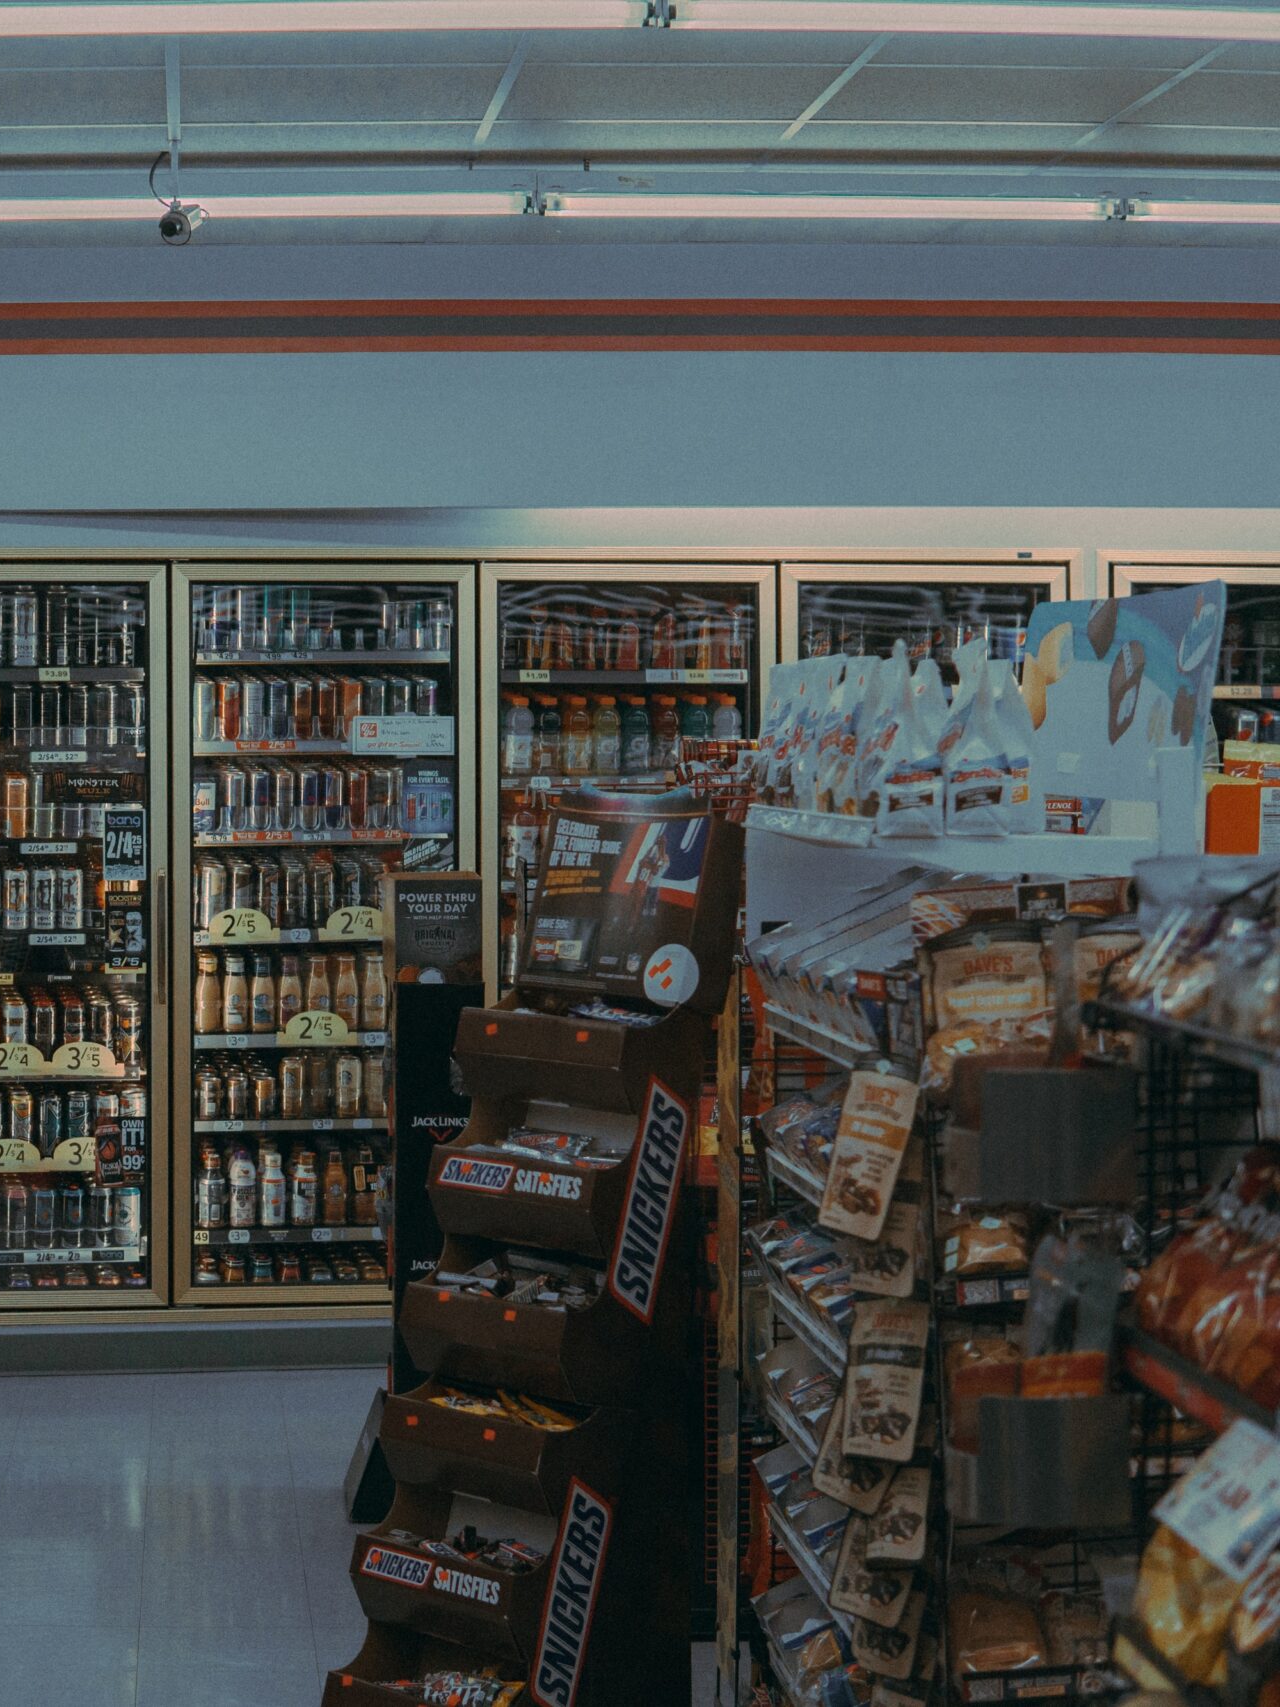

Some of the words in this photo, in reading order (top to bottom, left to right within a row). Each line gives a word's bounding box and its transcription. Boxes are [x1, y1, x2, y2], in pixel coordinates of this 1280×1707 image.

[67, 777, 119, 788] MONSTER
[107, 815, 141, 827] bang
[554, 834, 569, 851] THE
[548, 850, 560, 867] OF
[560, 851, 577, 867] THE
[399, 893, 442, 903] POWER
[444, 893, 476, 903] THRU
[407, 903, 441, 913] YOUR
[444, 903, 468, 913] DAY
[537, 917, 556, 929] SAVE
[963, 956, 1014, 975] DAVE'S
[121, 1119, 145, 1128] OWN
[411, 1115, 438, 1127] JACK
[122, 1128, 145, 1146] IT!
[122, 1154, 145, 1170] 99¢
[612, 1090, 684, 1308] SNICKERS
[409, 1259, 436, 1271] JACK
[539, 1495, 607, 1707] SNICKERS
